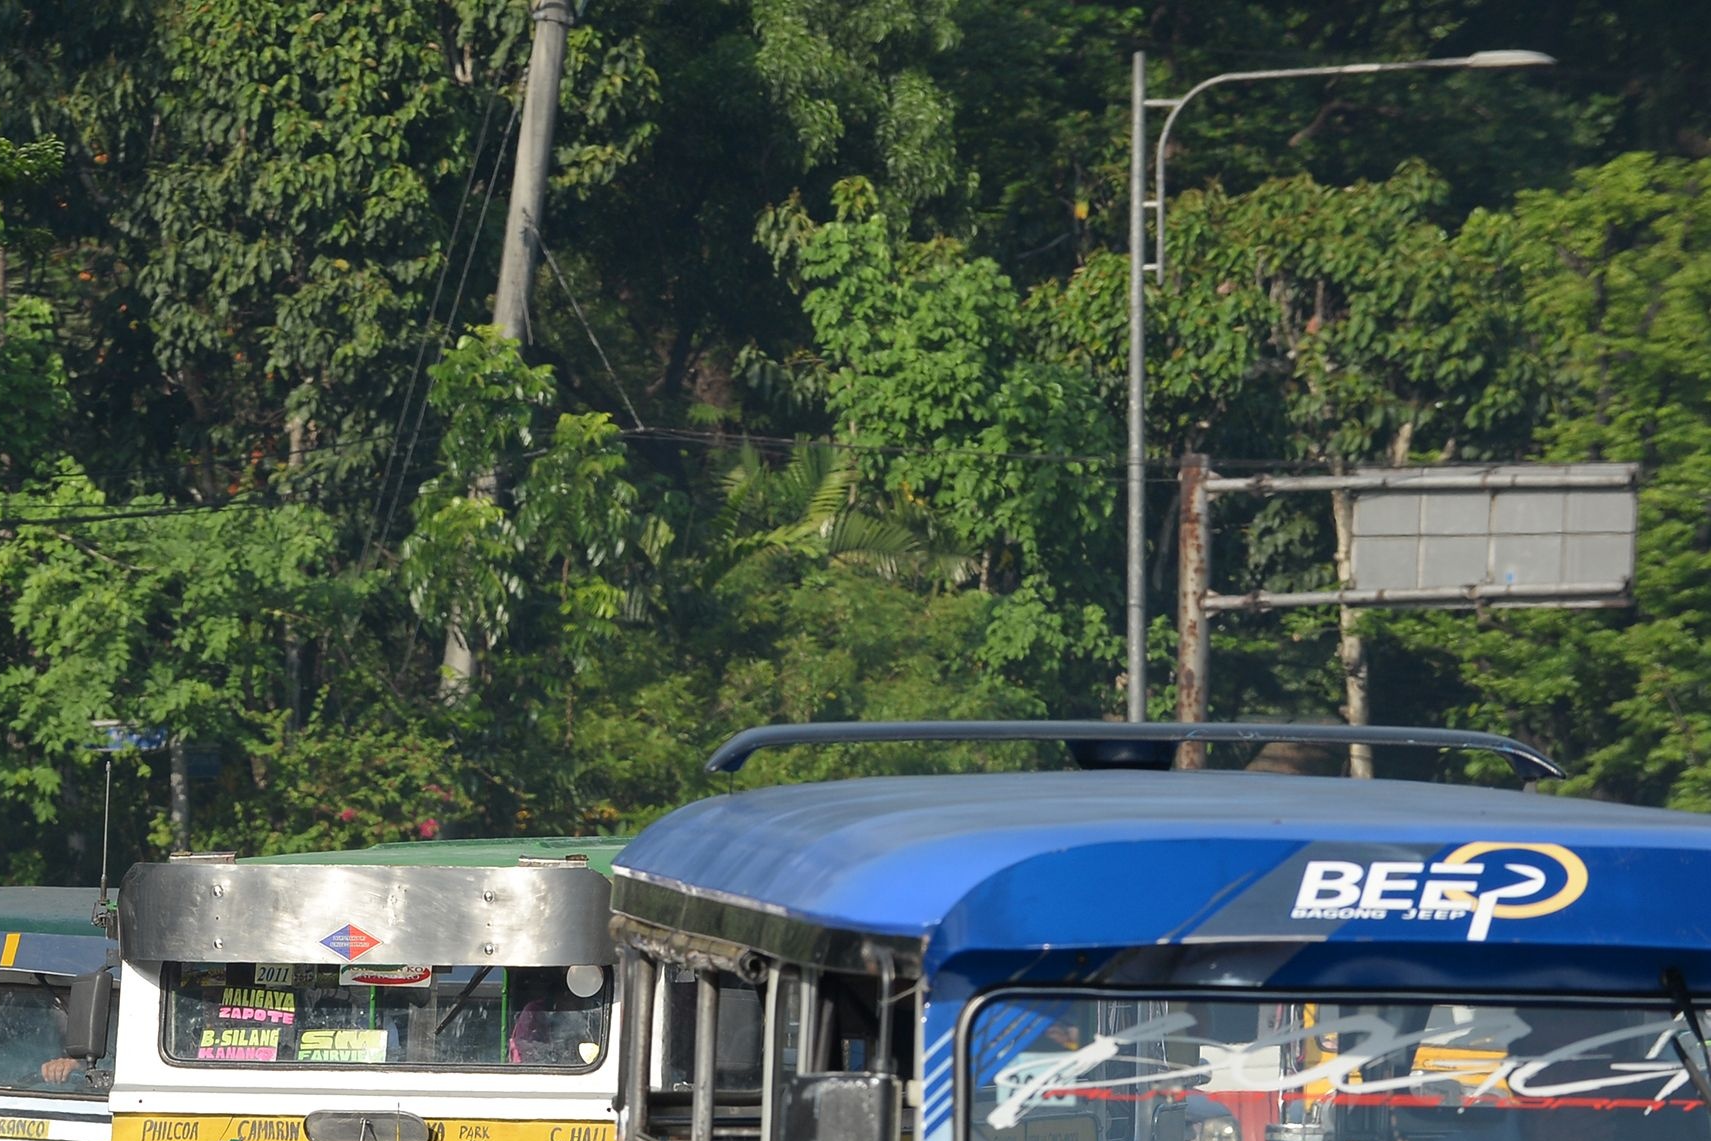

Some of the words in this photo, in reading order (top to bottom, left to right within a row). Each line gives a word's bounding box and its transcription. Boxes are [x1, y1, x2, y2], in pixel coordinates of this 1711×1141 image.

[1294, 860, 1547, 942] BEEP
[1290, 906, 1387, 920] BAGONG
[1401, 906, 1467, 921] JEEP
[256, 966, 289, 982] 2011
[222, 988, 295, 1011] MALIGAYA
[218, 1007, 296, 1025] ZAPOTE
[201, 1029, 279, 1047] B.SILANG
[301, 1031, 375, 1050] SM
[141, 1119, 199, 1141] PHILCOA
[237, 1120, 301, 1141] CAMARIN
[458, 1125, 490, 1139] PARK
